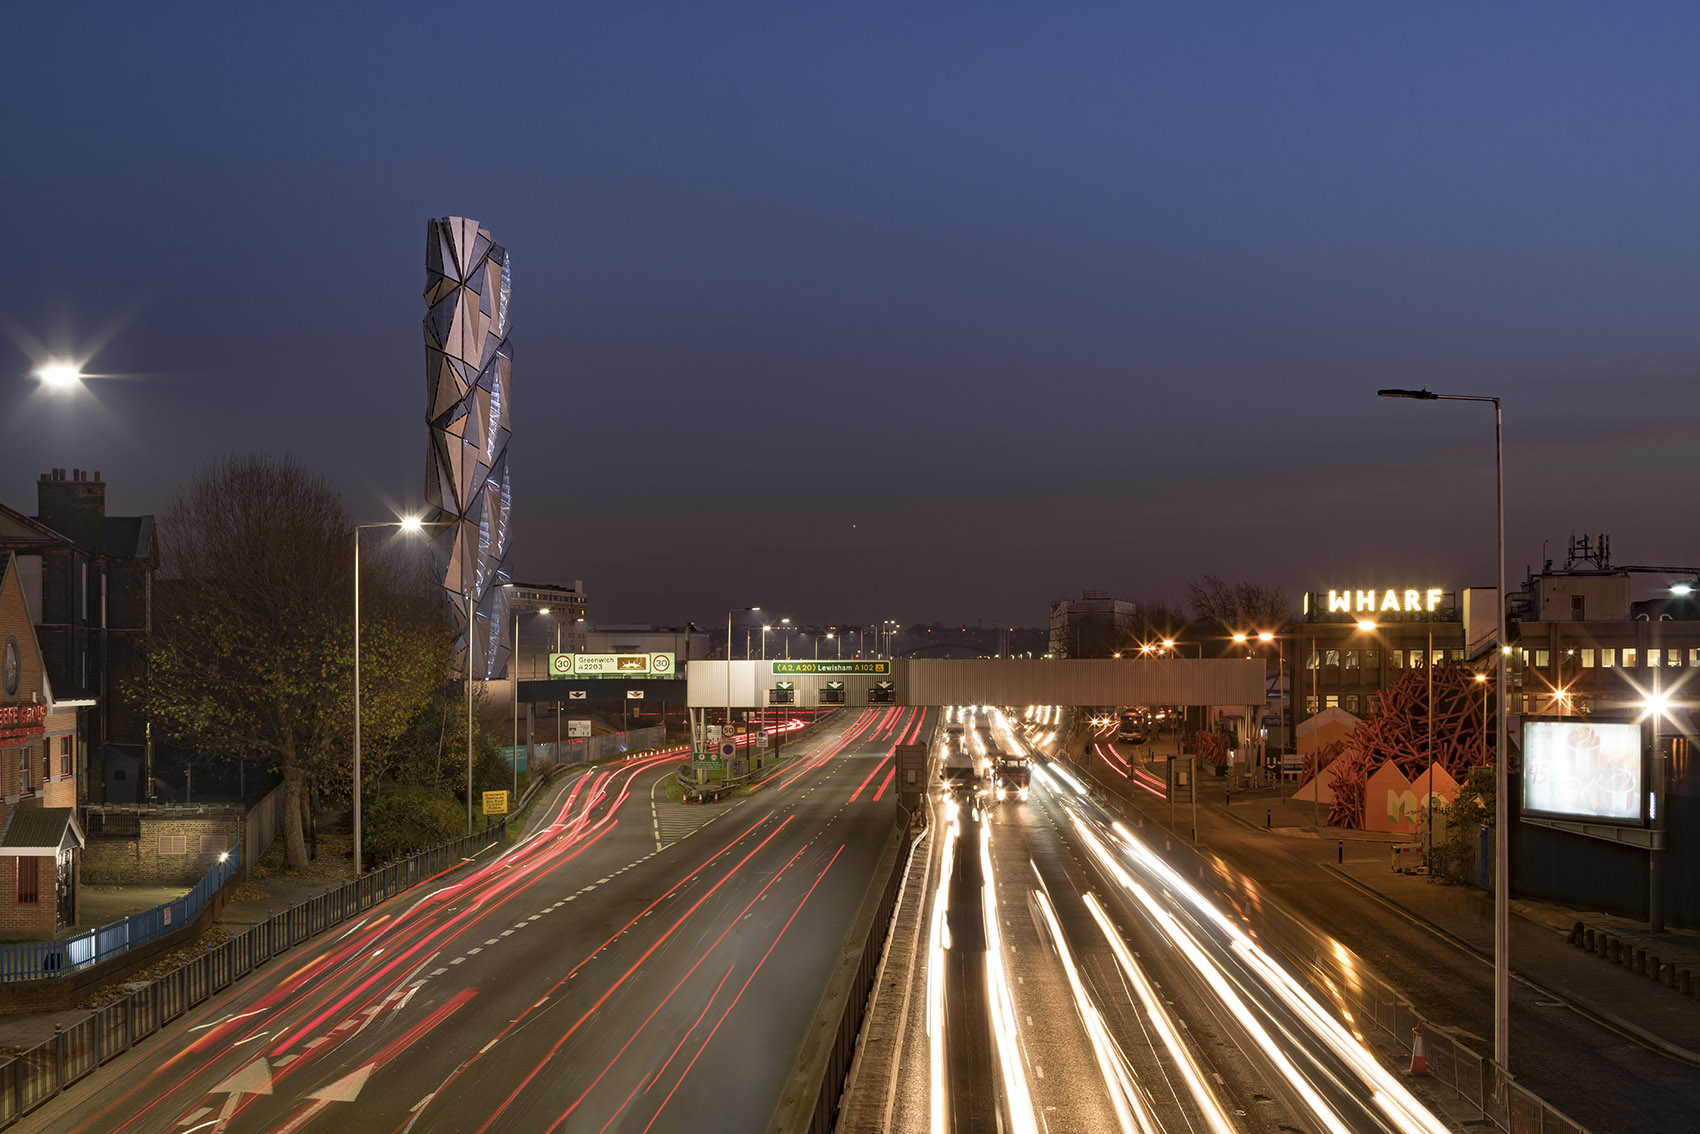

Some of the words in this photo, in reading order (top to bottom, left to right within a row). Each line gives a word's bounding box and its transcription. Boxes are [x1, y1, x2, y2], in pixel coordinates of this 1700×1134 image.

[1328, 589, 1443, 612] WHARF
[557, 660, 569, 668] 30
[655, 659, 668, 667] 30
[796, 664, 816, 672] A20)
